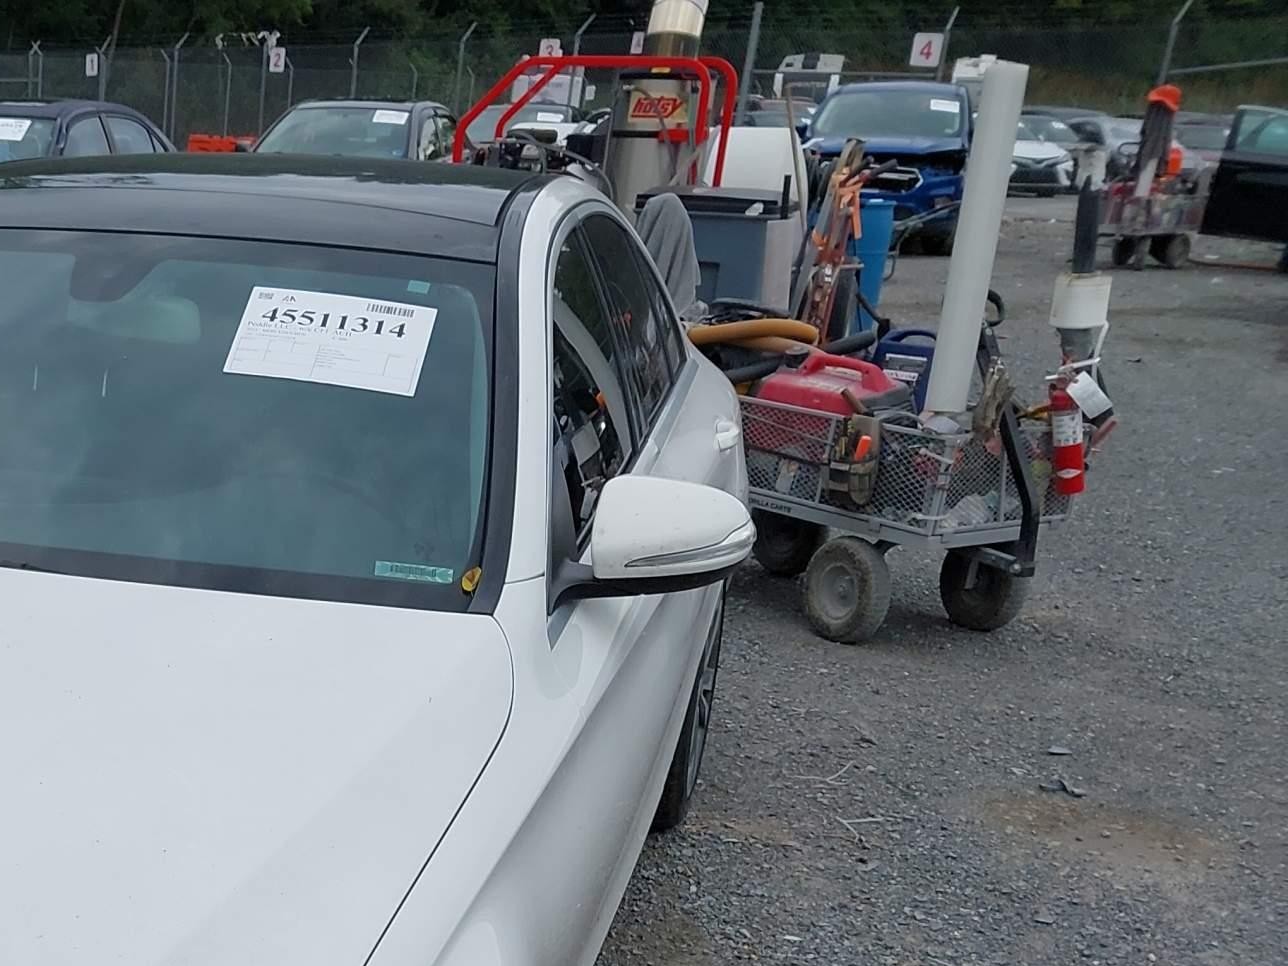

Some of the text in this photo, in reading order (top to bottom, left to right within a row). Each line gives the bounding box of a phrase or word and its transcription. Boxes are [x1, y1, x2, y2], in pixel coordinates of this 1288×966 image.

[919, 40, 933, 60] 4
[274, 53, 281, 68] 2
[261, 306, 407, 338] 45511314
